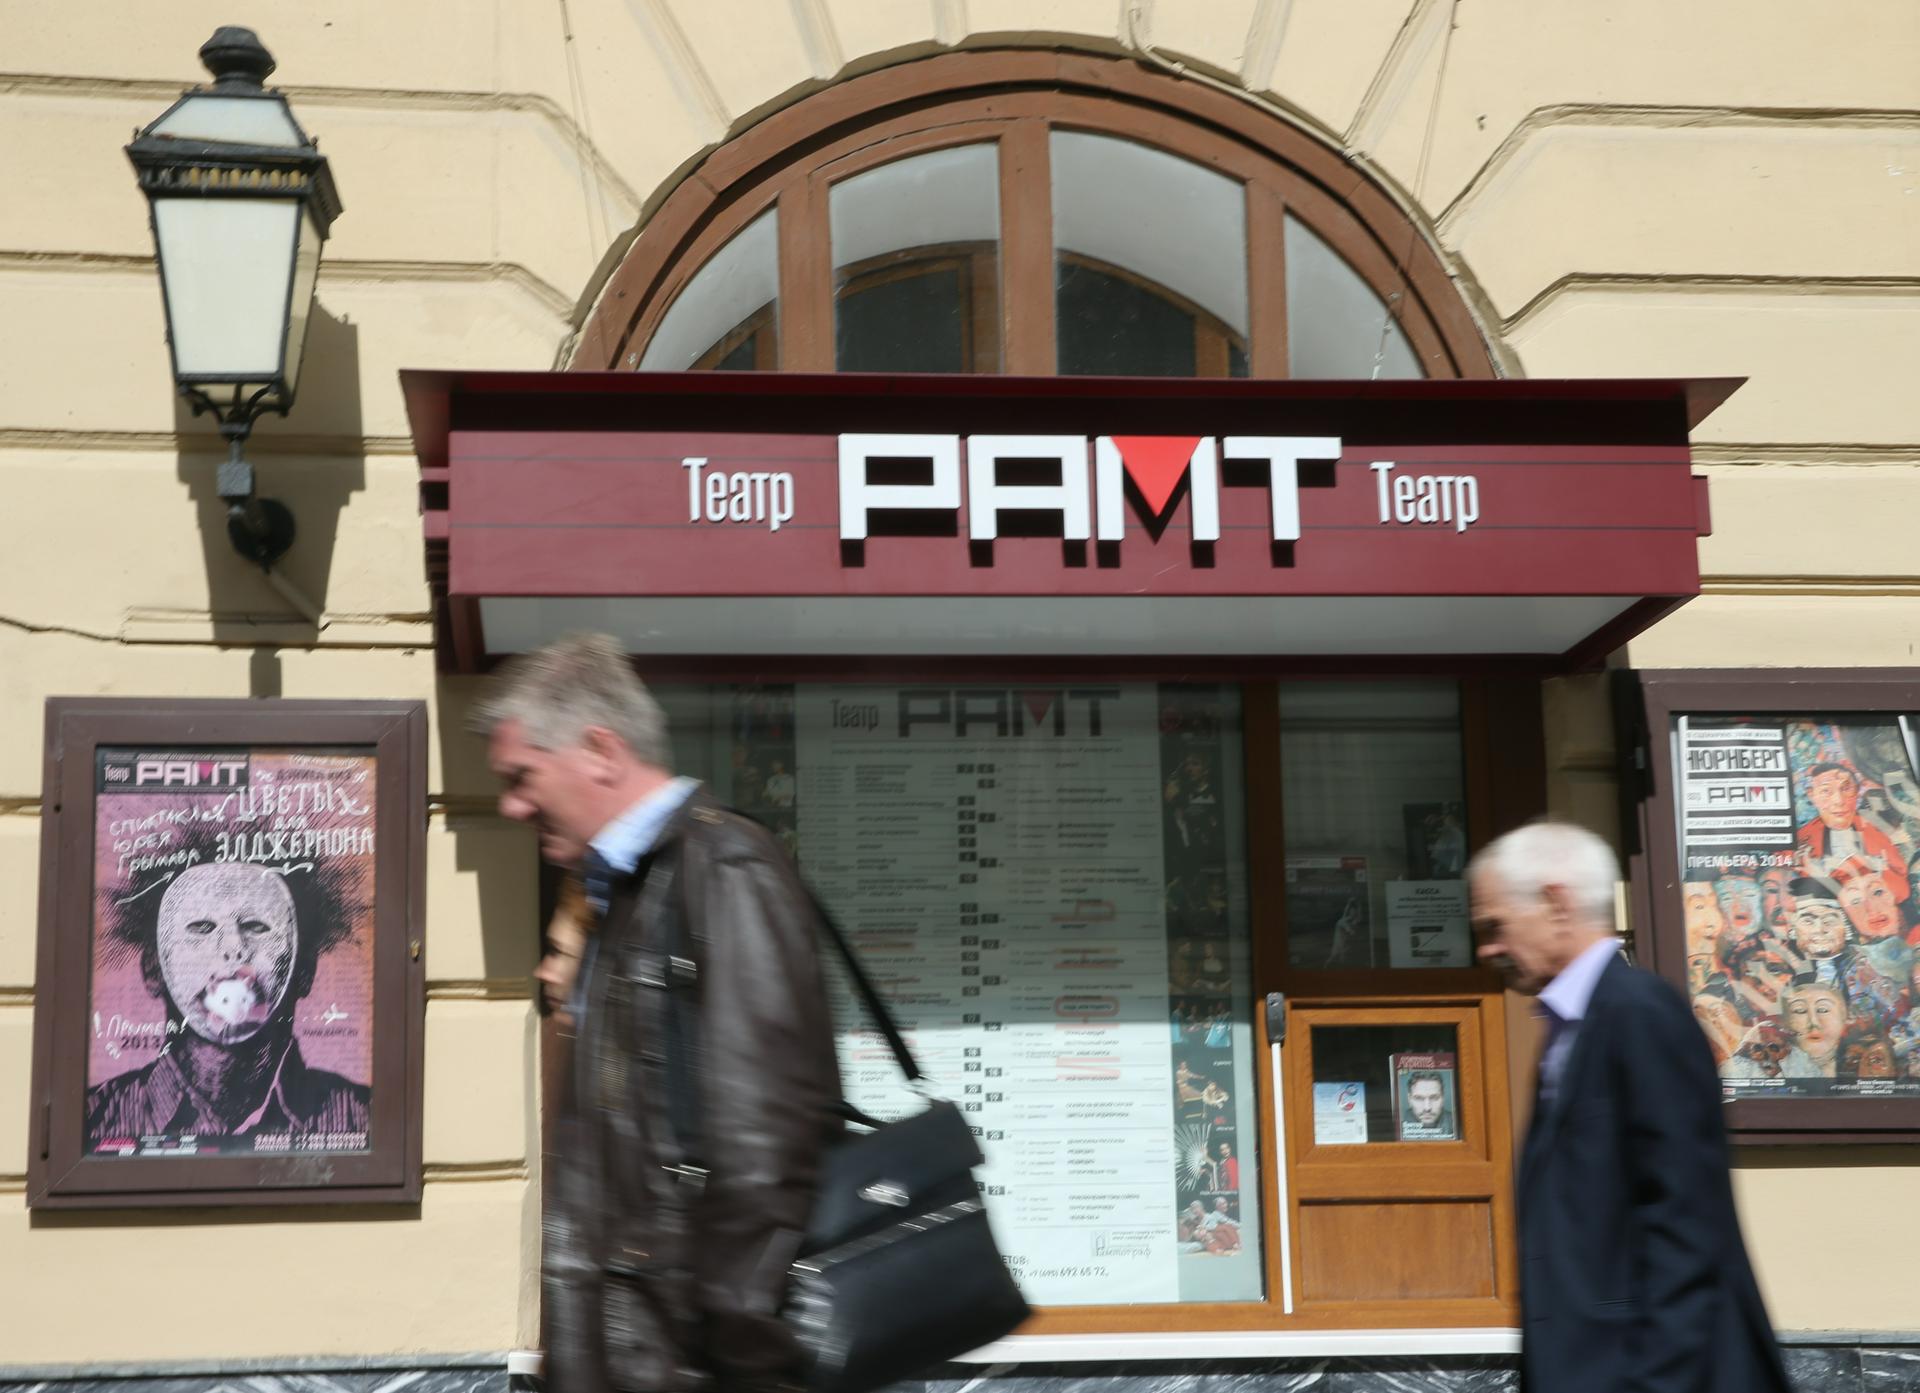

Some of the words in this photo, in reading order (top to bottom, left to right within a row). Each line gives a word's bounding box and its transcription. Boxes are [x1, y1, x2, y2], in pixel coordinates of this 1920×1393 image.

[682, 457, 795, 531] Театр
[838, 433, 1343, 543] РАМТ
[1370, 461, 1481, 533] Театр
[831, 699, 879, 733] Театр
[899, 689, 1120, 738] РАМТ
[136, 761, 247, 786] РАМТ
[1708, 786, 1784, 804] РАМТ
[1687, 854, 1758, 868] ПРЕМЬЕРА
[1759, 854, 1792, 867] 2014
[121, 1035, 162, 1051] 2013
[1001, 1255, 1029, 1266] ЕТОВ:
